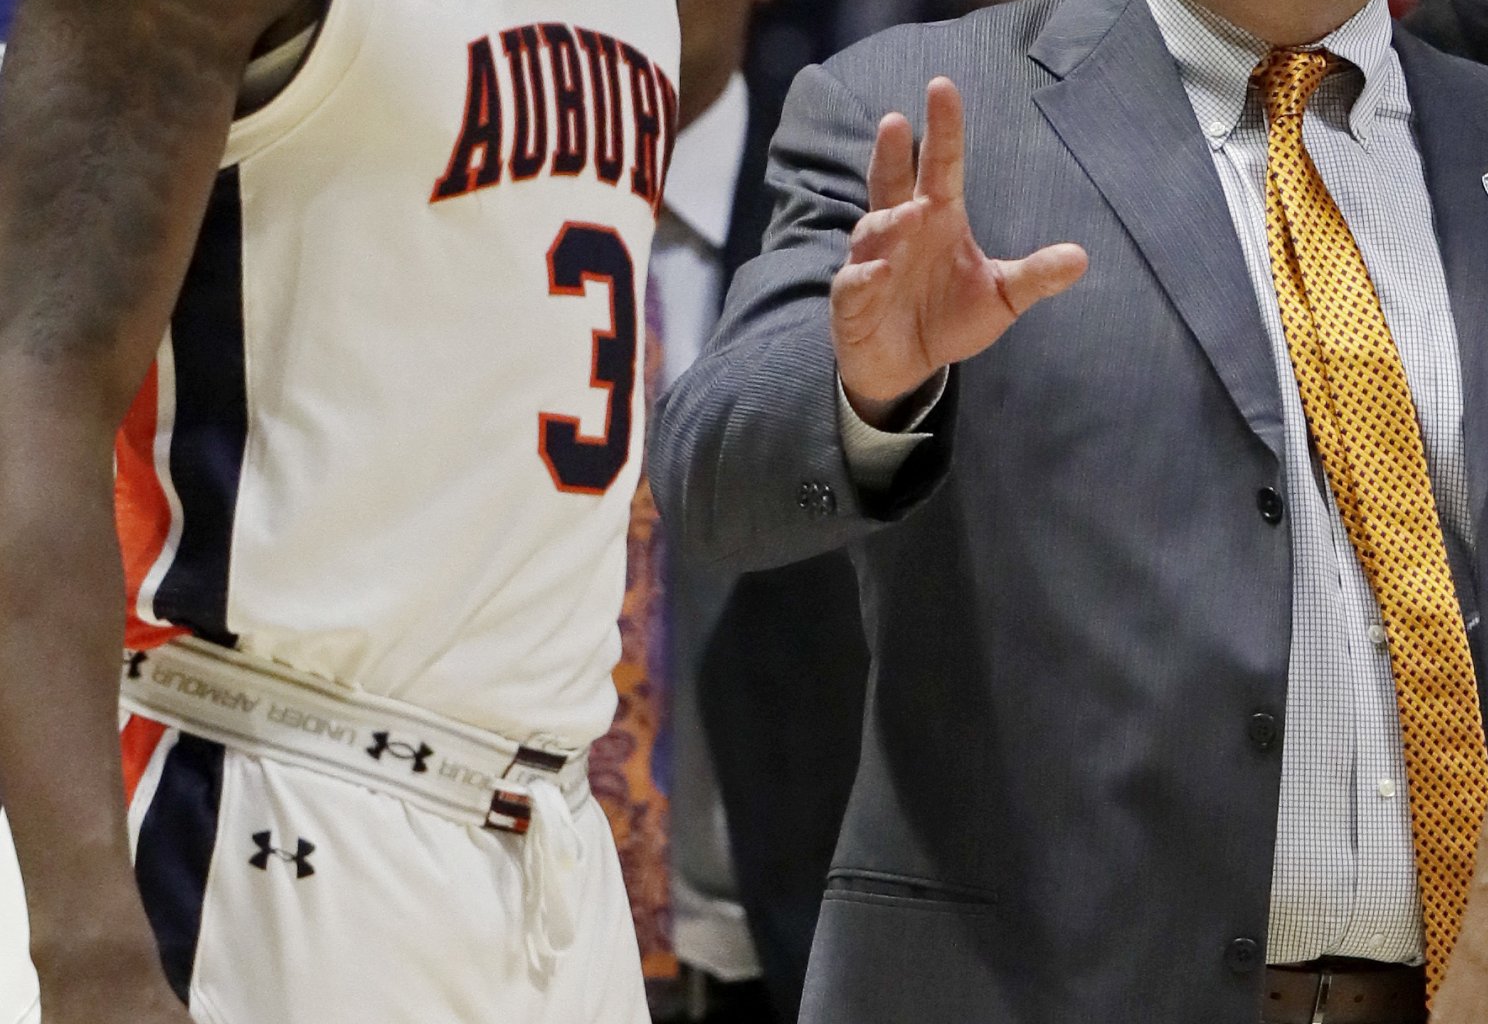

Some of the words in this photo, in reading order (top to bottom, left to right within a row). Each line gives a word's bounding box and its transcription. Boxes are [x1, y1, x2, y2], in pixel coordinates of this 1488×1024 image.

[538, 219, 638, 497] 3
[152, 666, 259, 713] ARMOUR
[267, 704, 358, 746] UNDER
